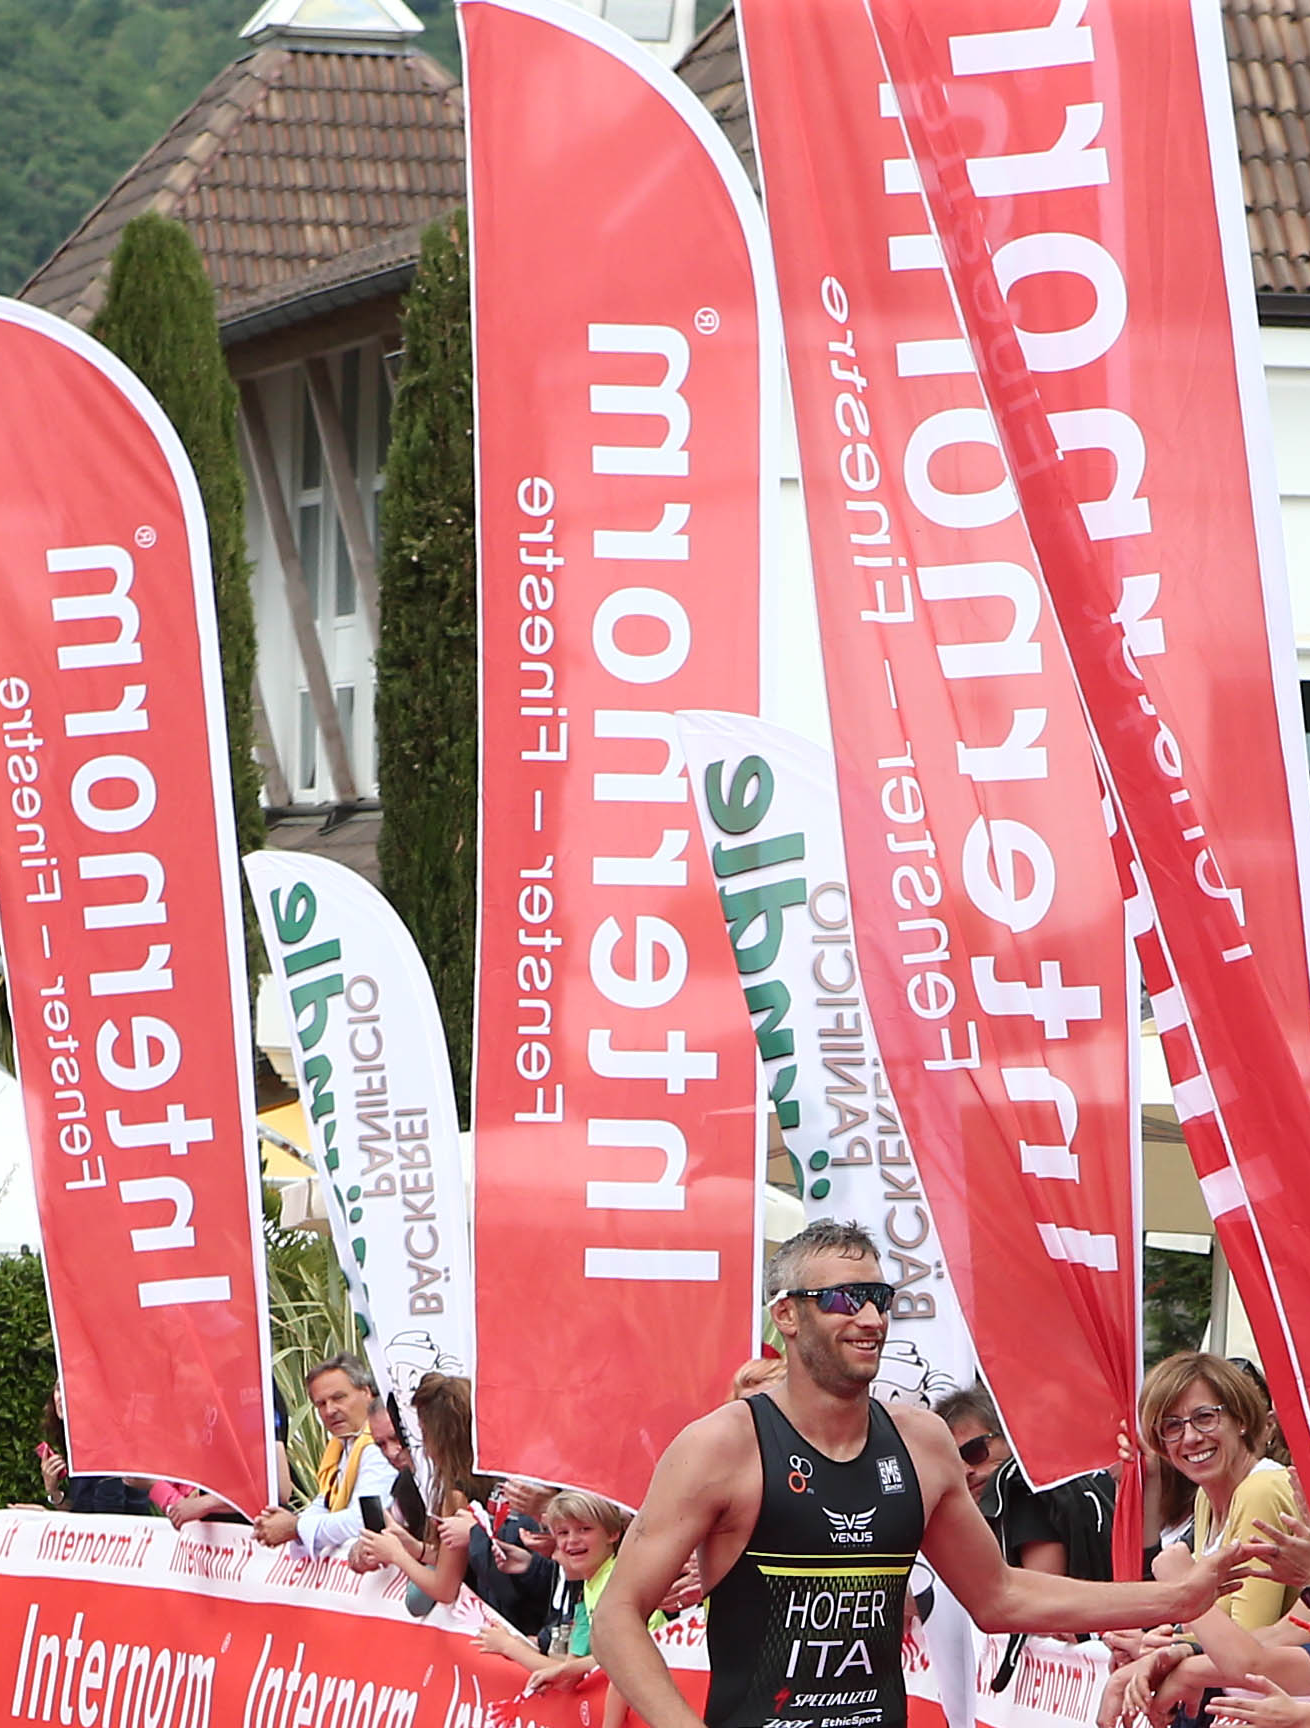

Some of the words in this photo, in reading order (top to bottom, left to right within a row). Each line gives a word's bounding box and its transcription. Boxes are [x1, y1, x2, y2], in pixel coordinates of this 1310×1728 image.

[36, 1523, 155, 1570] Internorm.it
[830, 1531, 874, 1543] VENUS
[785, 1590, 886, 1630] HOFER
[786, 1639, 874, 1679] ITA
[790, 1688, 878, 1708] SPECIALIZED
[820, 1714, 883, 1728] EthicSport
